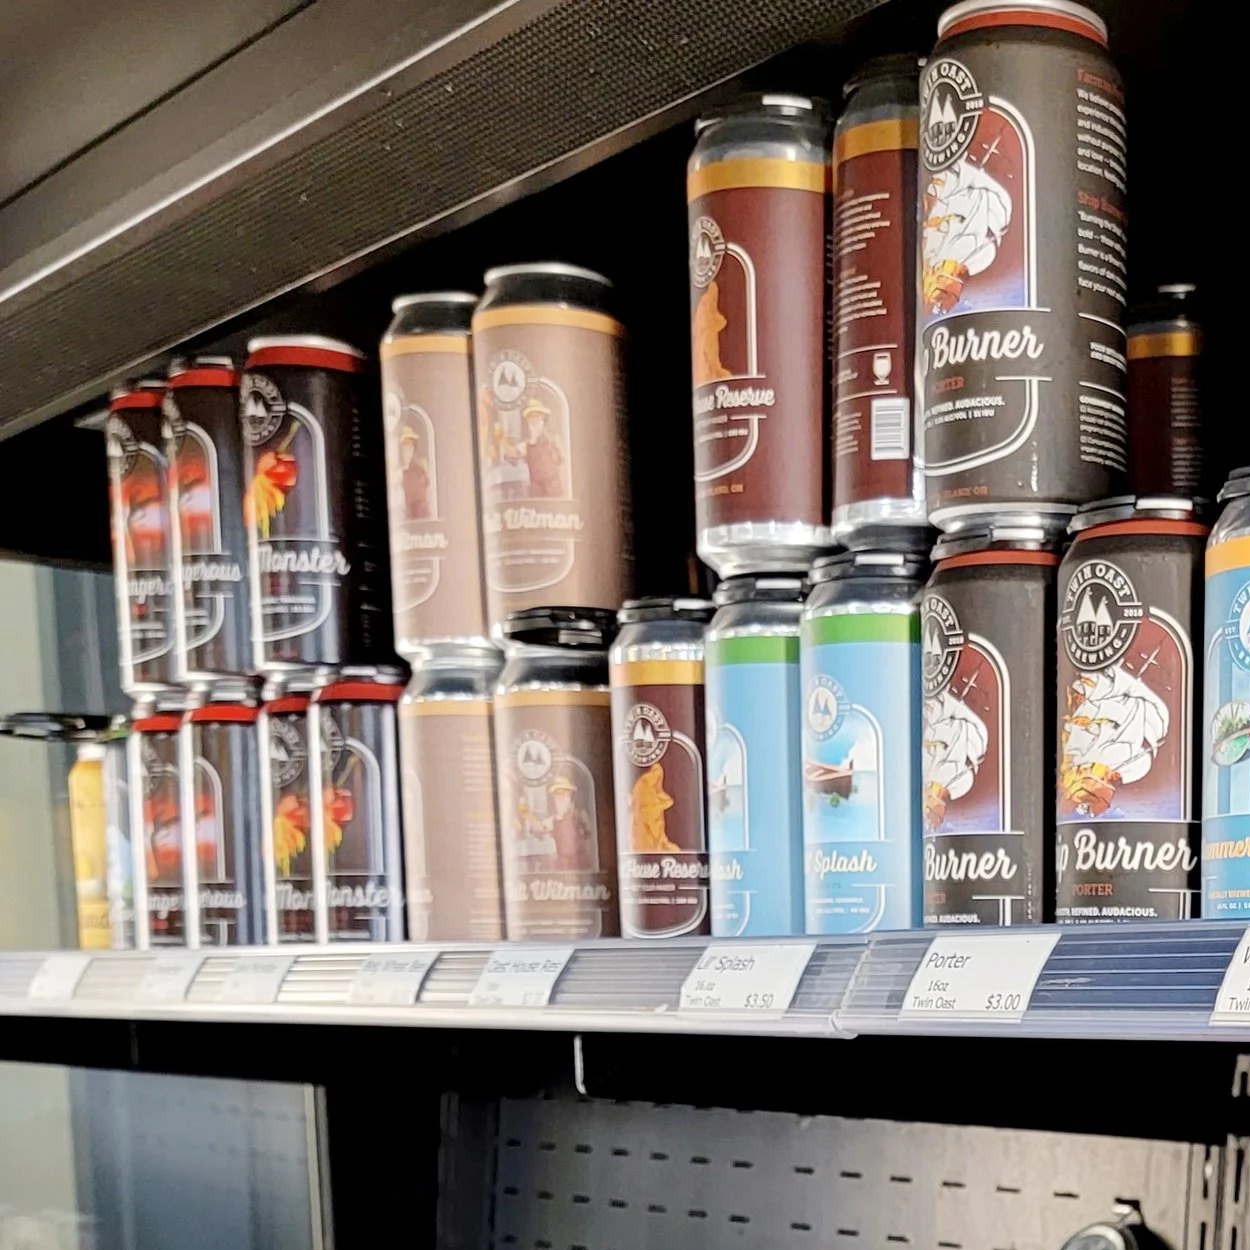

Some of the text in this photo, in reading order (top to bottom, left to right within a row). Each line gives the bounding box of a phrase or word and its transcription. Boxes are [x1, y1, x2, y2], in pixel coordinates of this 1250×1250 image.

[932, 325, 1044, 371] Burner
[924, 841, 1018, 882] Burner
[1073, 828, 1198, 873] Burner
[814, 851, 877, 877] Splash
[925, 952, 972, 969] Porter
[927, 979, 950, 992] 16oz
[912, 993, 1022, 1010] Twin Oast $3.00
